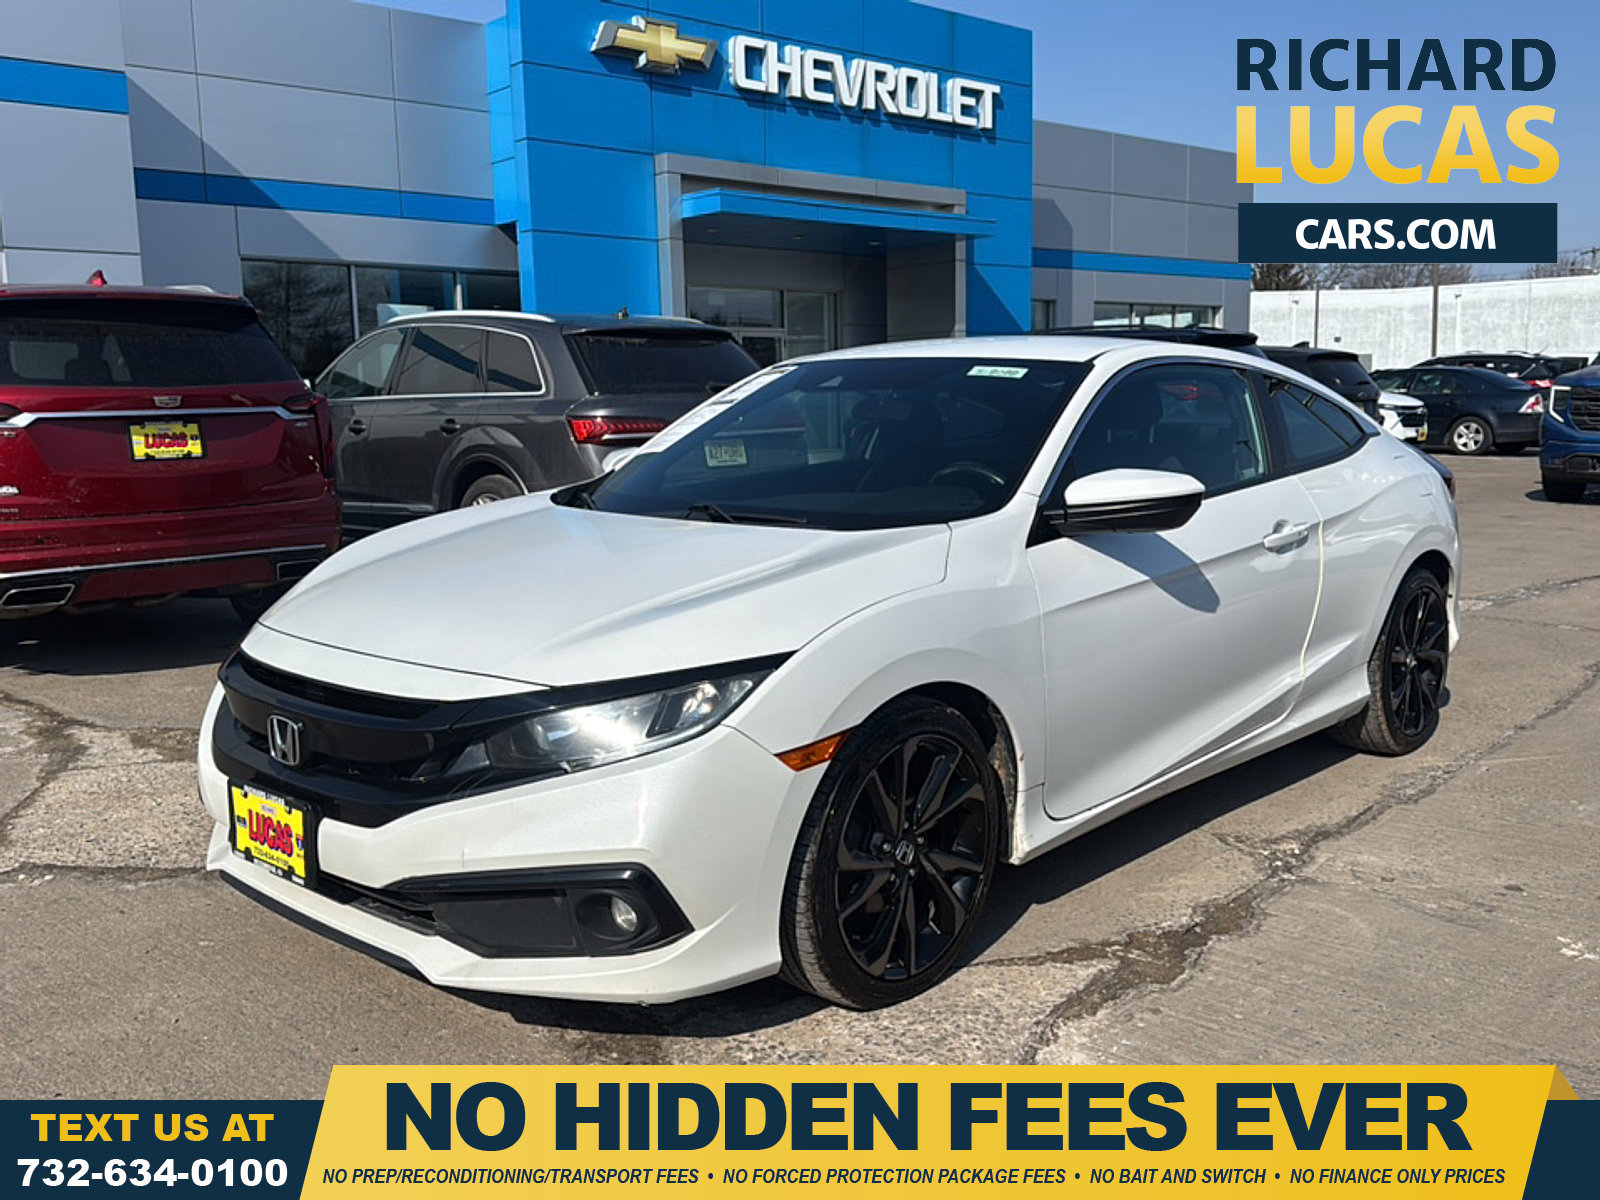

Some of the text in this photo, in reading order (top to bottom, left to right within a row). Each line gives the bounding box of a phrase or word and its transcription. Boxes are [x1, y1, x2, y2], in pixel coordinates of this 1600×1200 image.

[728, 34, 1001, 130] CHEVROLET
[143, 432, 188, 449] LUCAS
[248, 808, 294, 858] LUCAS
